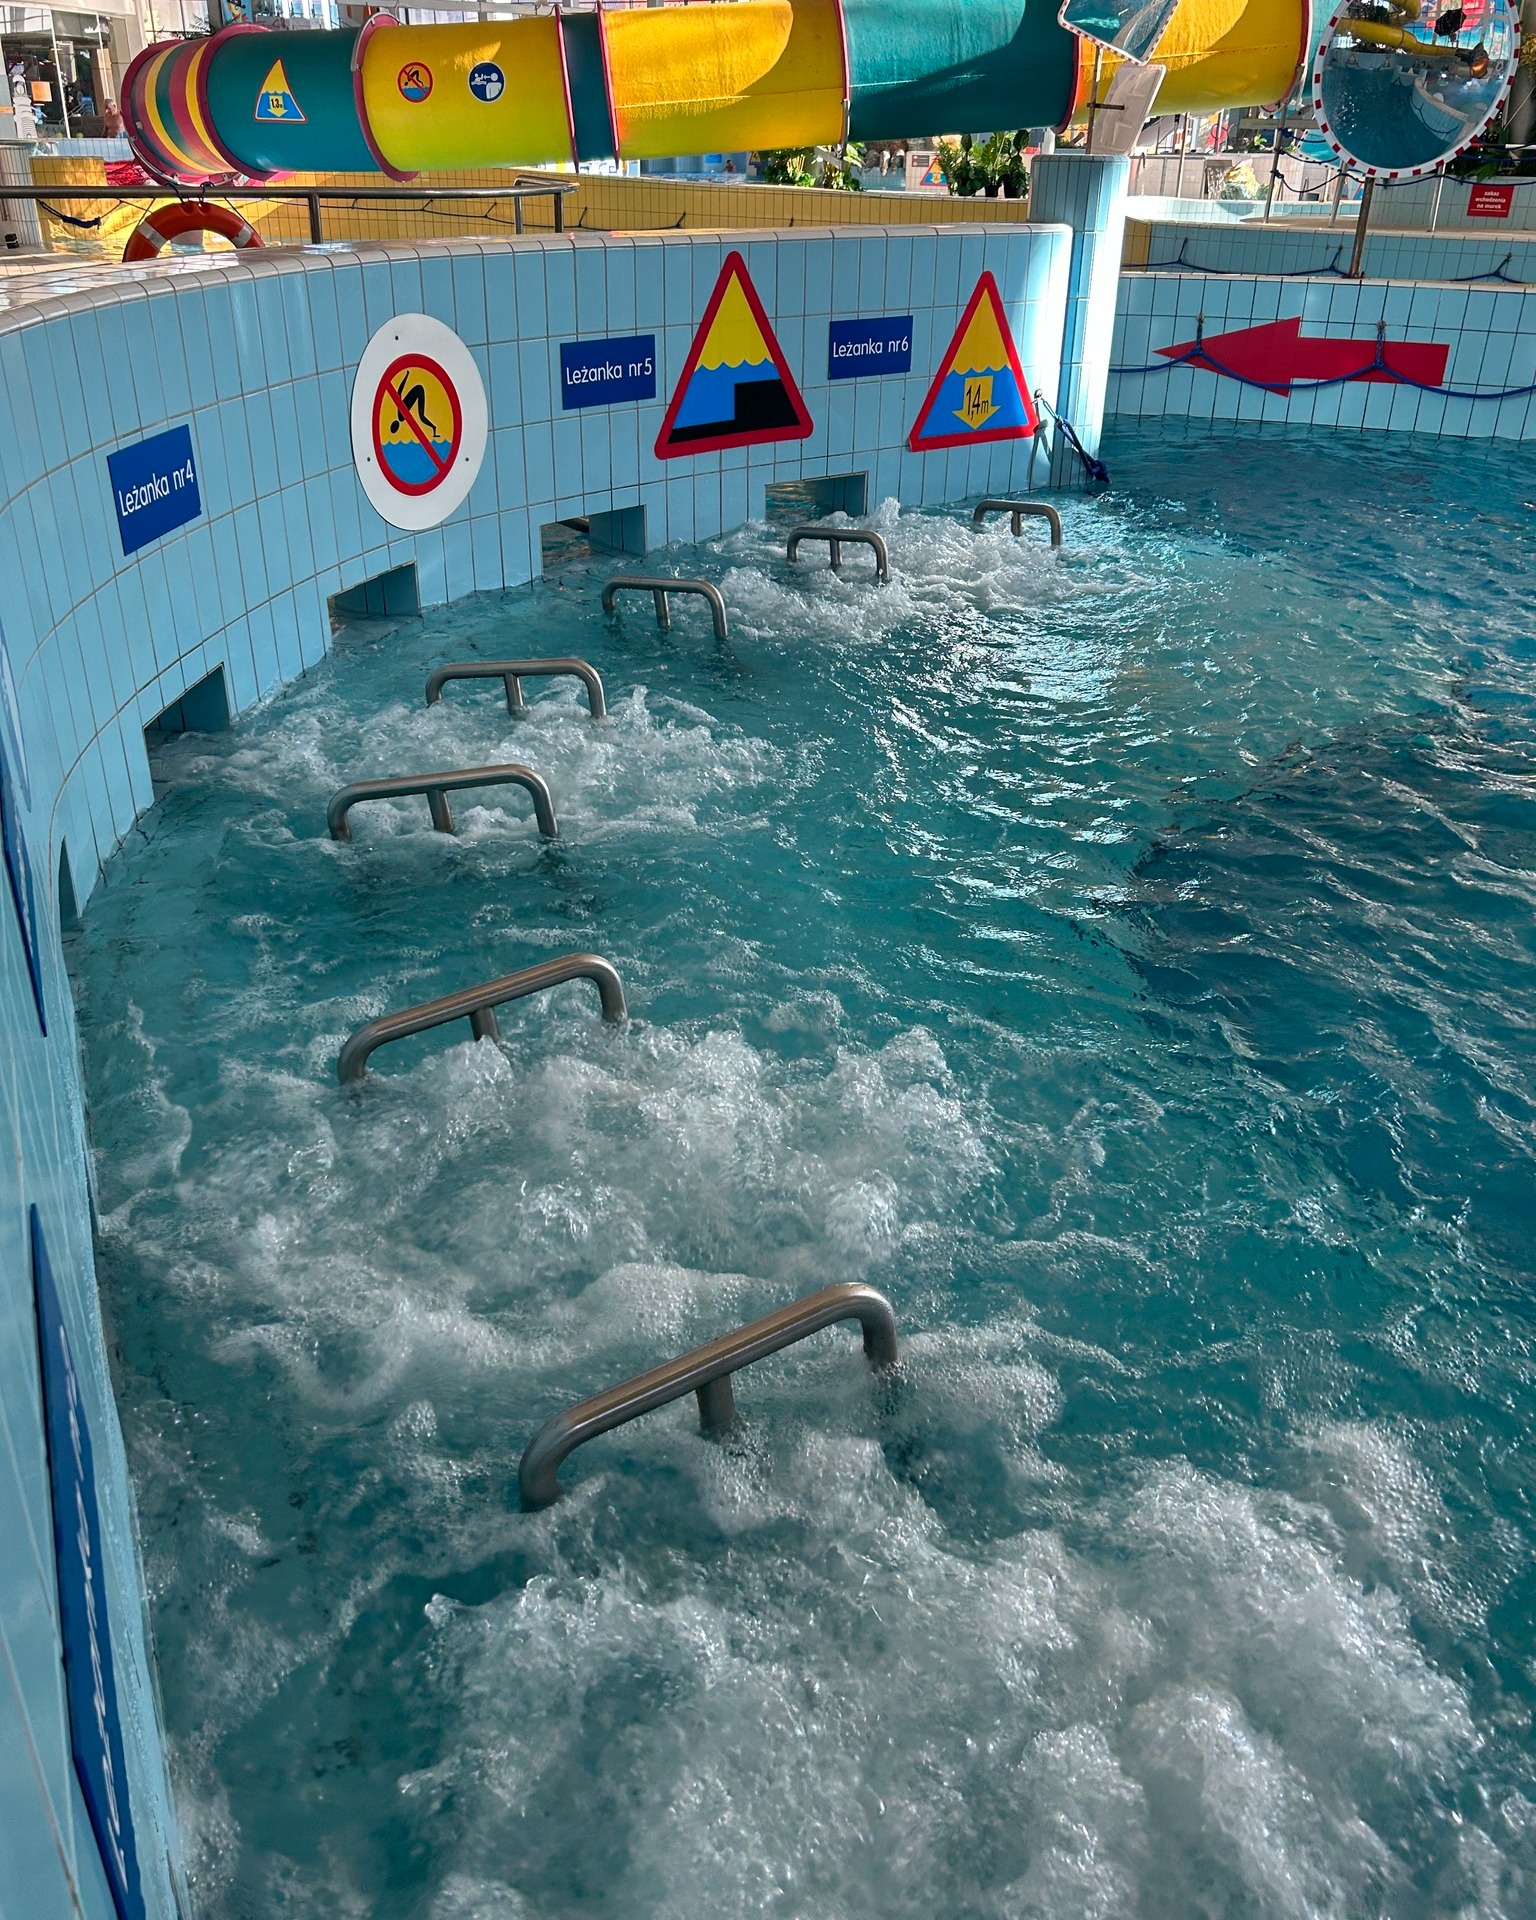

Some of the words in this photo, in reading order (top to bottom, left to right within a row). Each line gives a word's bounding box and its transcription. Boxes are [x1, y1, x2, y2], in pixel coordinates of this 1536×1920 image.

[832, 337, 883, 358] Leżanka
[566, 360, 623, 385] Leżanka
[118, 472, 170, 517] Leżanka
